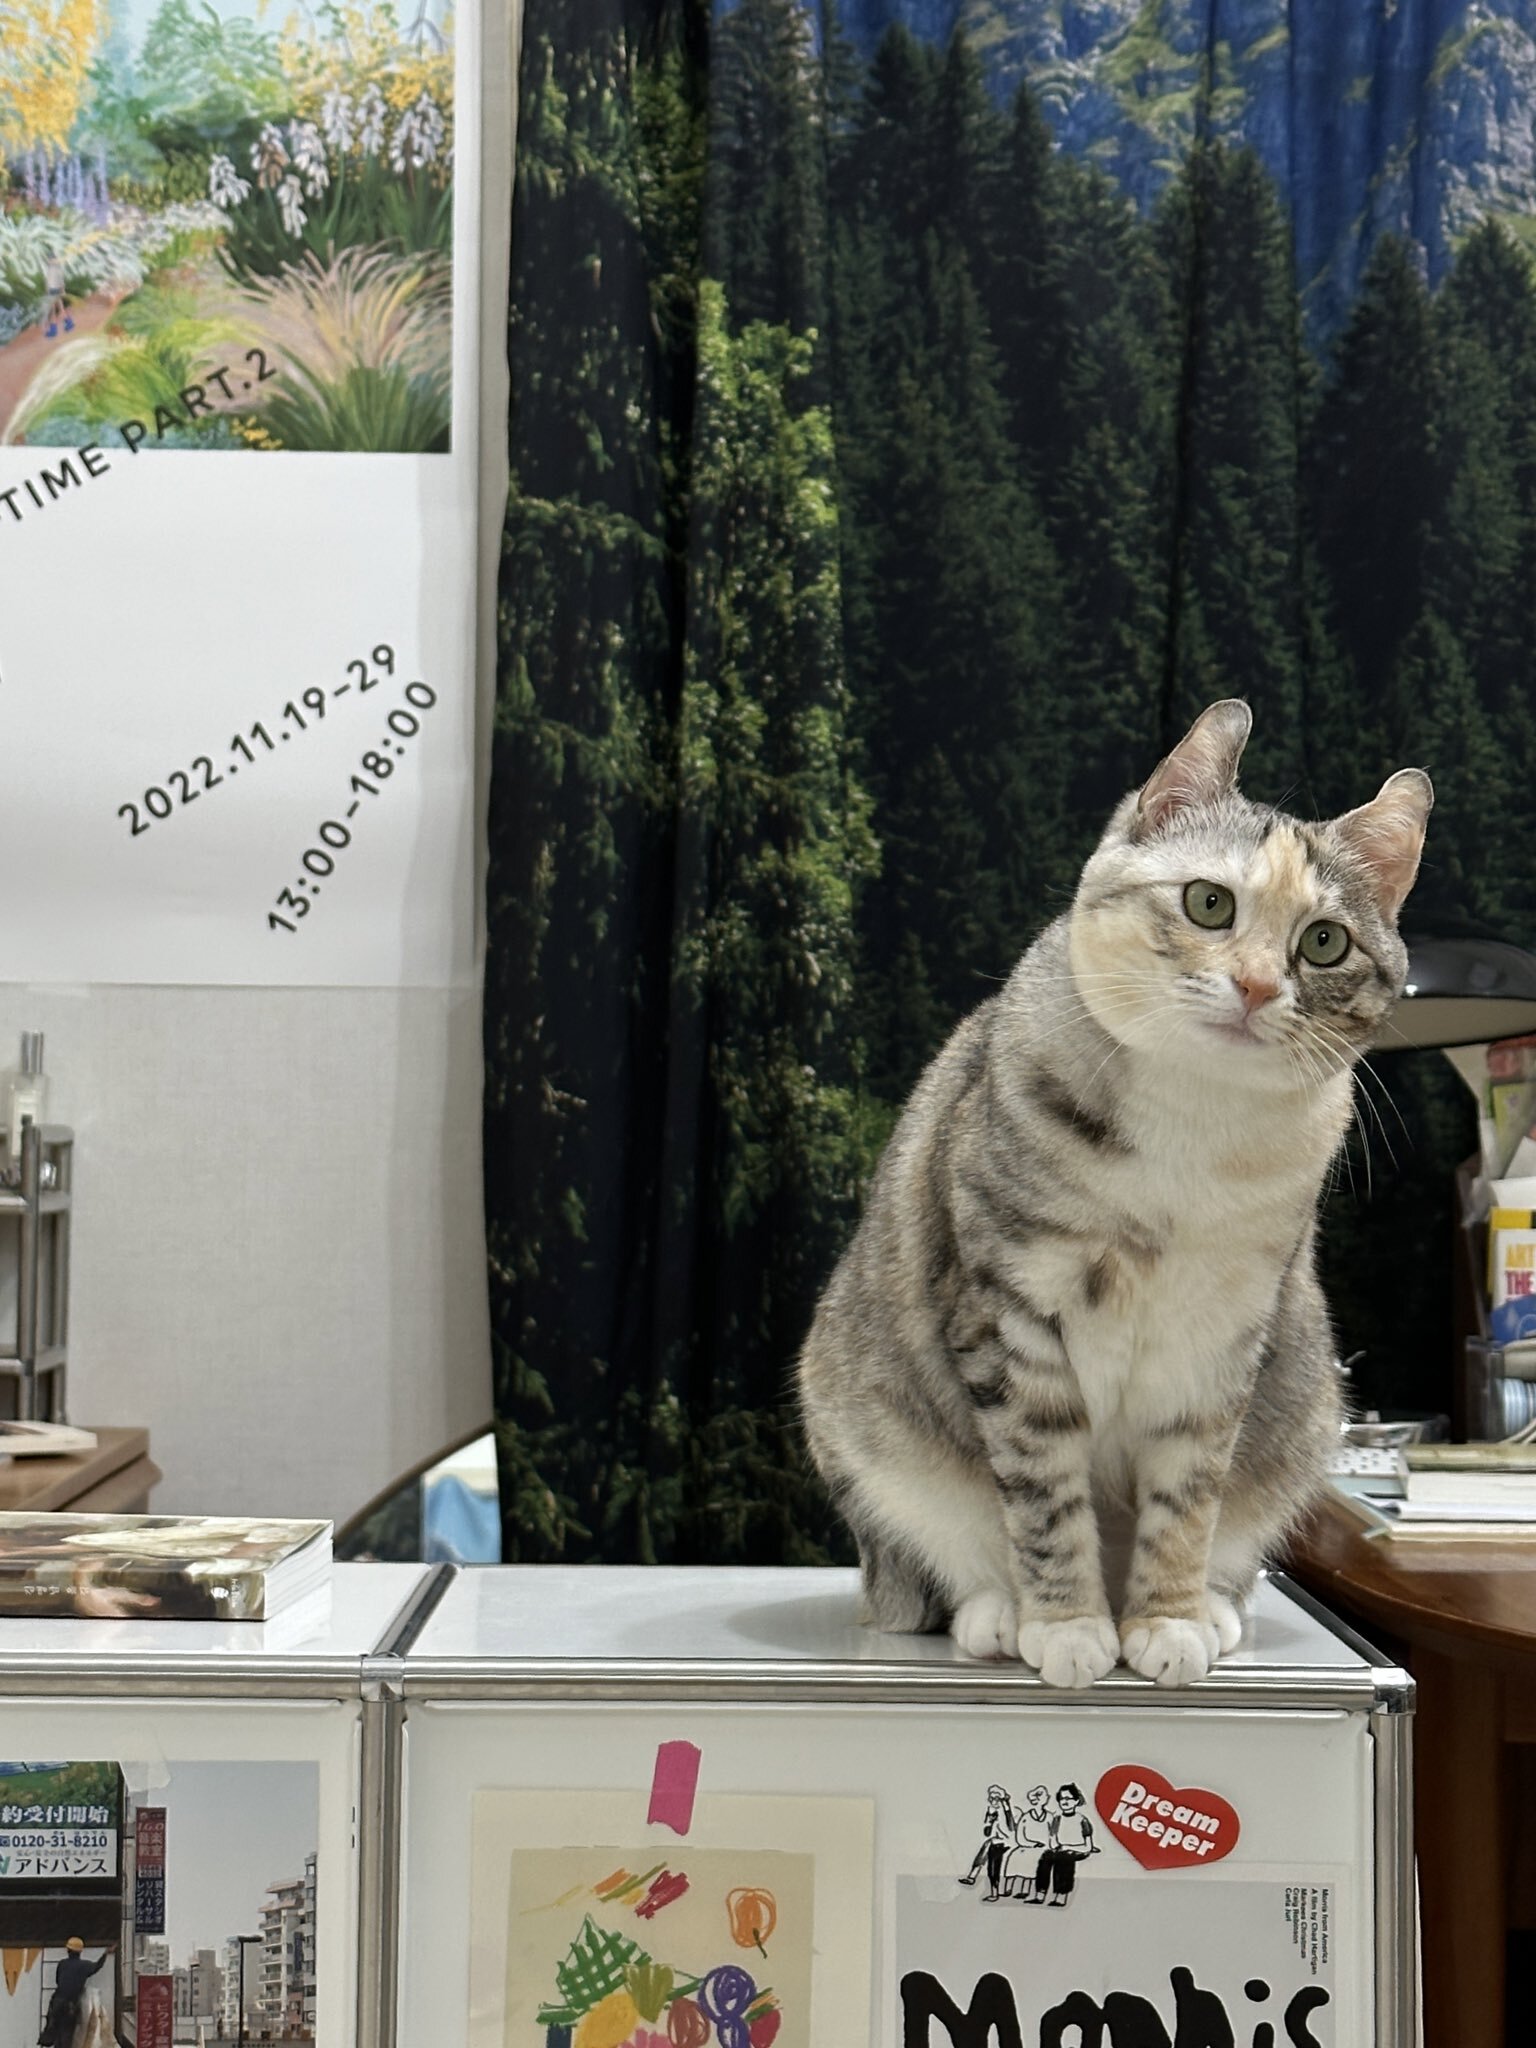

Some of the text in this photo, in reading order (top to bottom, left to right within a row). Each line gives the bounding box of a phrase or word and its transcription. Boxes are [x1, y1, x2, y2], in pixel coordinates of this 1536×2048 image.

[120, 348, 277, 454] PART.2
[267, 680, 438, 933] 13:00-18:00
[1120, 1781, 1220, 1834] Dream
[12, 1835, 108, 1848] 0120-31-8210
[1110, 1802, 1215, 1856] Keeper
[15, 1856, 108, 1875] アドバンス
[1310, 1912, 1318, 1921] by
[1311, 1922, 1319, 1942] Chad
